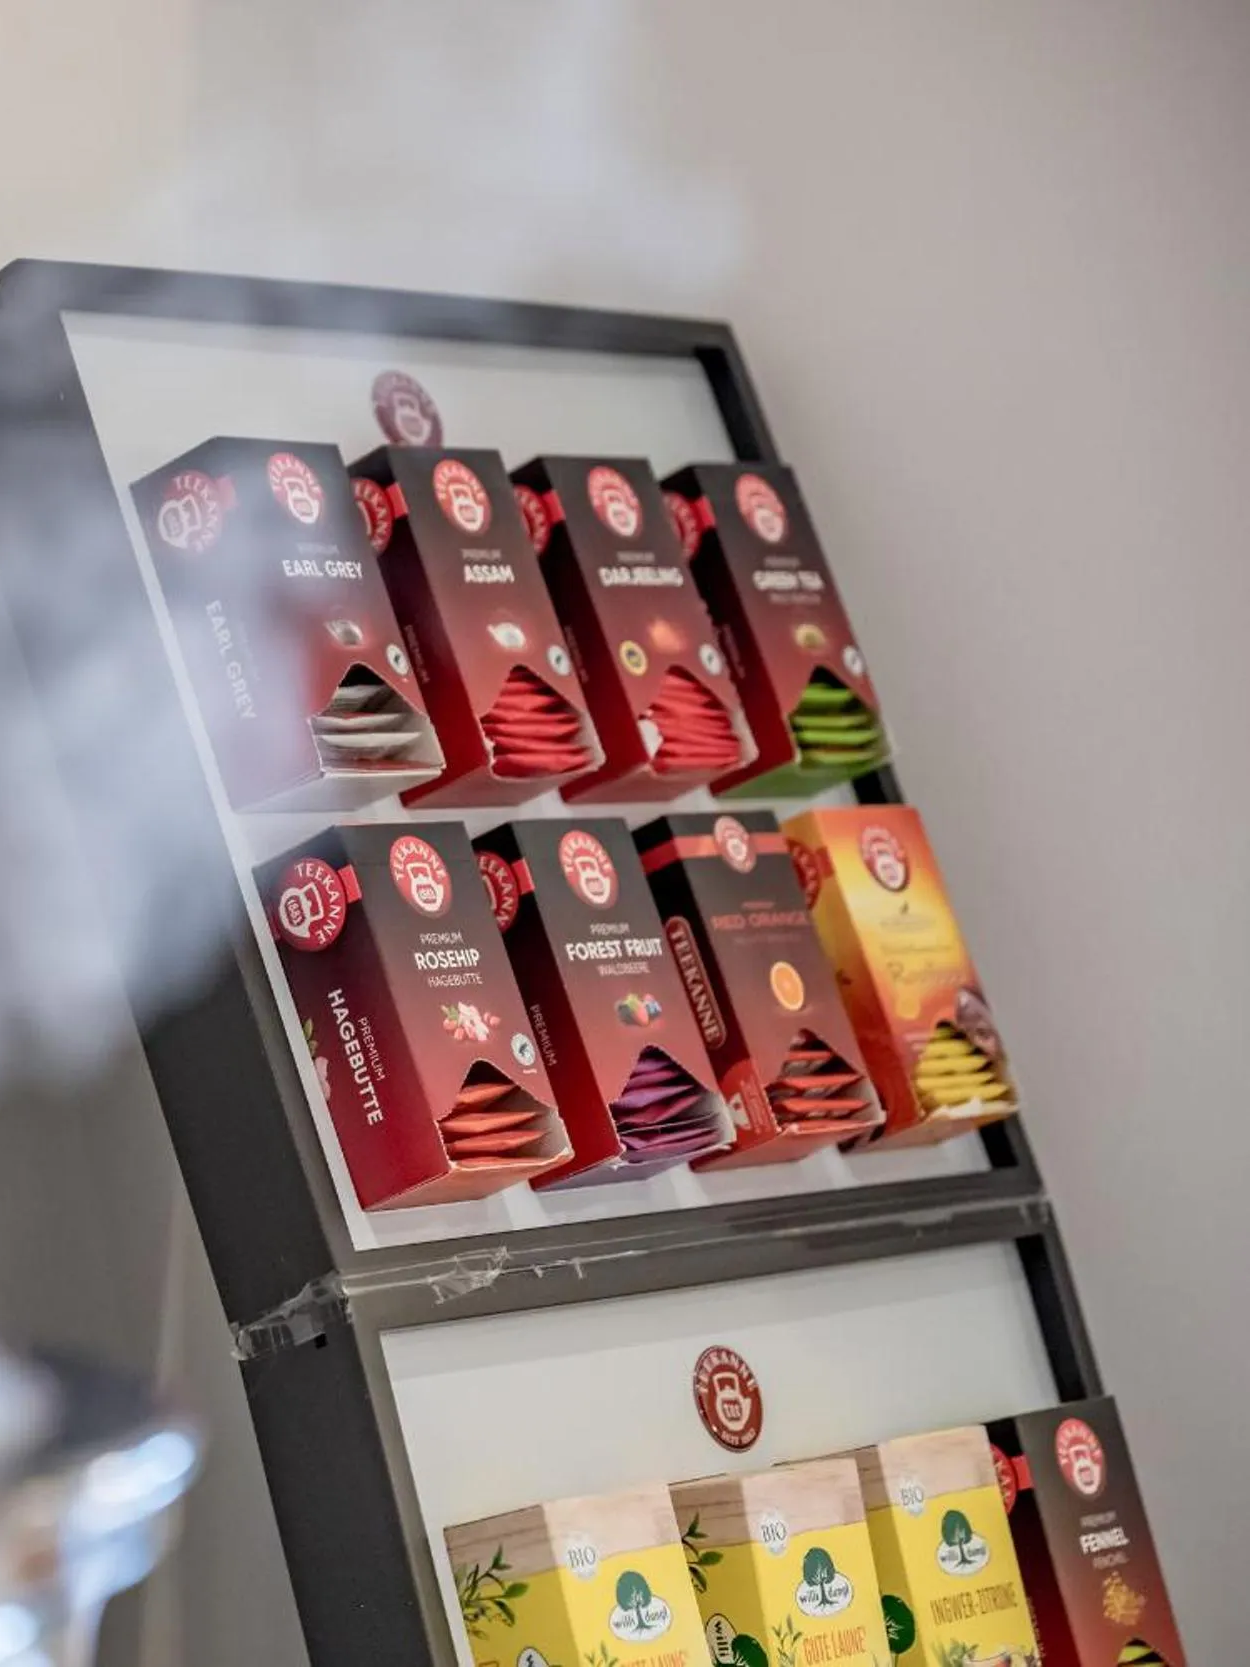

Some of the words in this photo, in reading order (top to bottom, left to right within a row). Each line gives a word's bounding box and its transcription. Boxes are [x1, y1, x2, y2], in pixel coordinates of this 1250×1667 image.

[282, 559, 324, 577] EARL
[324, 560, 363, 580] GREY
[463, 564, 515, 583] ASSAM
[205, 600, 233, 659] EARL
[226, 660, 257, 719] GREY
[390, 840, 447, 881] TEEKANNE
[294, 863, 342, 945] TEEKANNE
[419, 931, 465, 945] PREMIUM
[414, 948, 480, 971] ROSEHIP
[565, 939, 623, 962] FOREST
[624, 938, 663, 957] FRUIT
[428, 972, 484, 988] HAGEBUTTE
[669, 925, 720, 1045] TEEKANNE
[327, 988, 384, 1126] HAGEBUTTE
[358, 1017, 386, 1081] PREMIUM
[900, 1485, 924, 1507] BIO
[760, 1522, 787, 1544] BIO
[568, 1547, 596, 1569] BIO
[713, 1620, 730, 1659] willi
